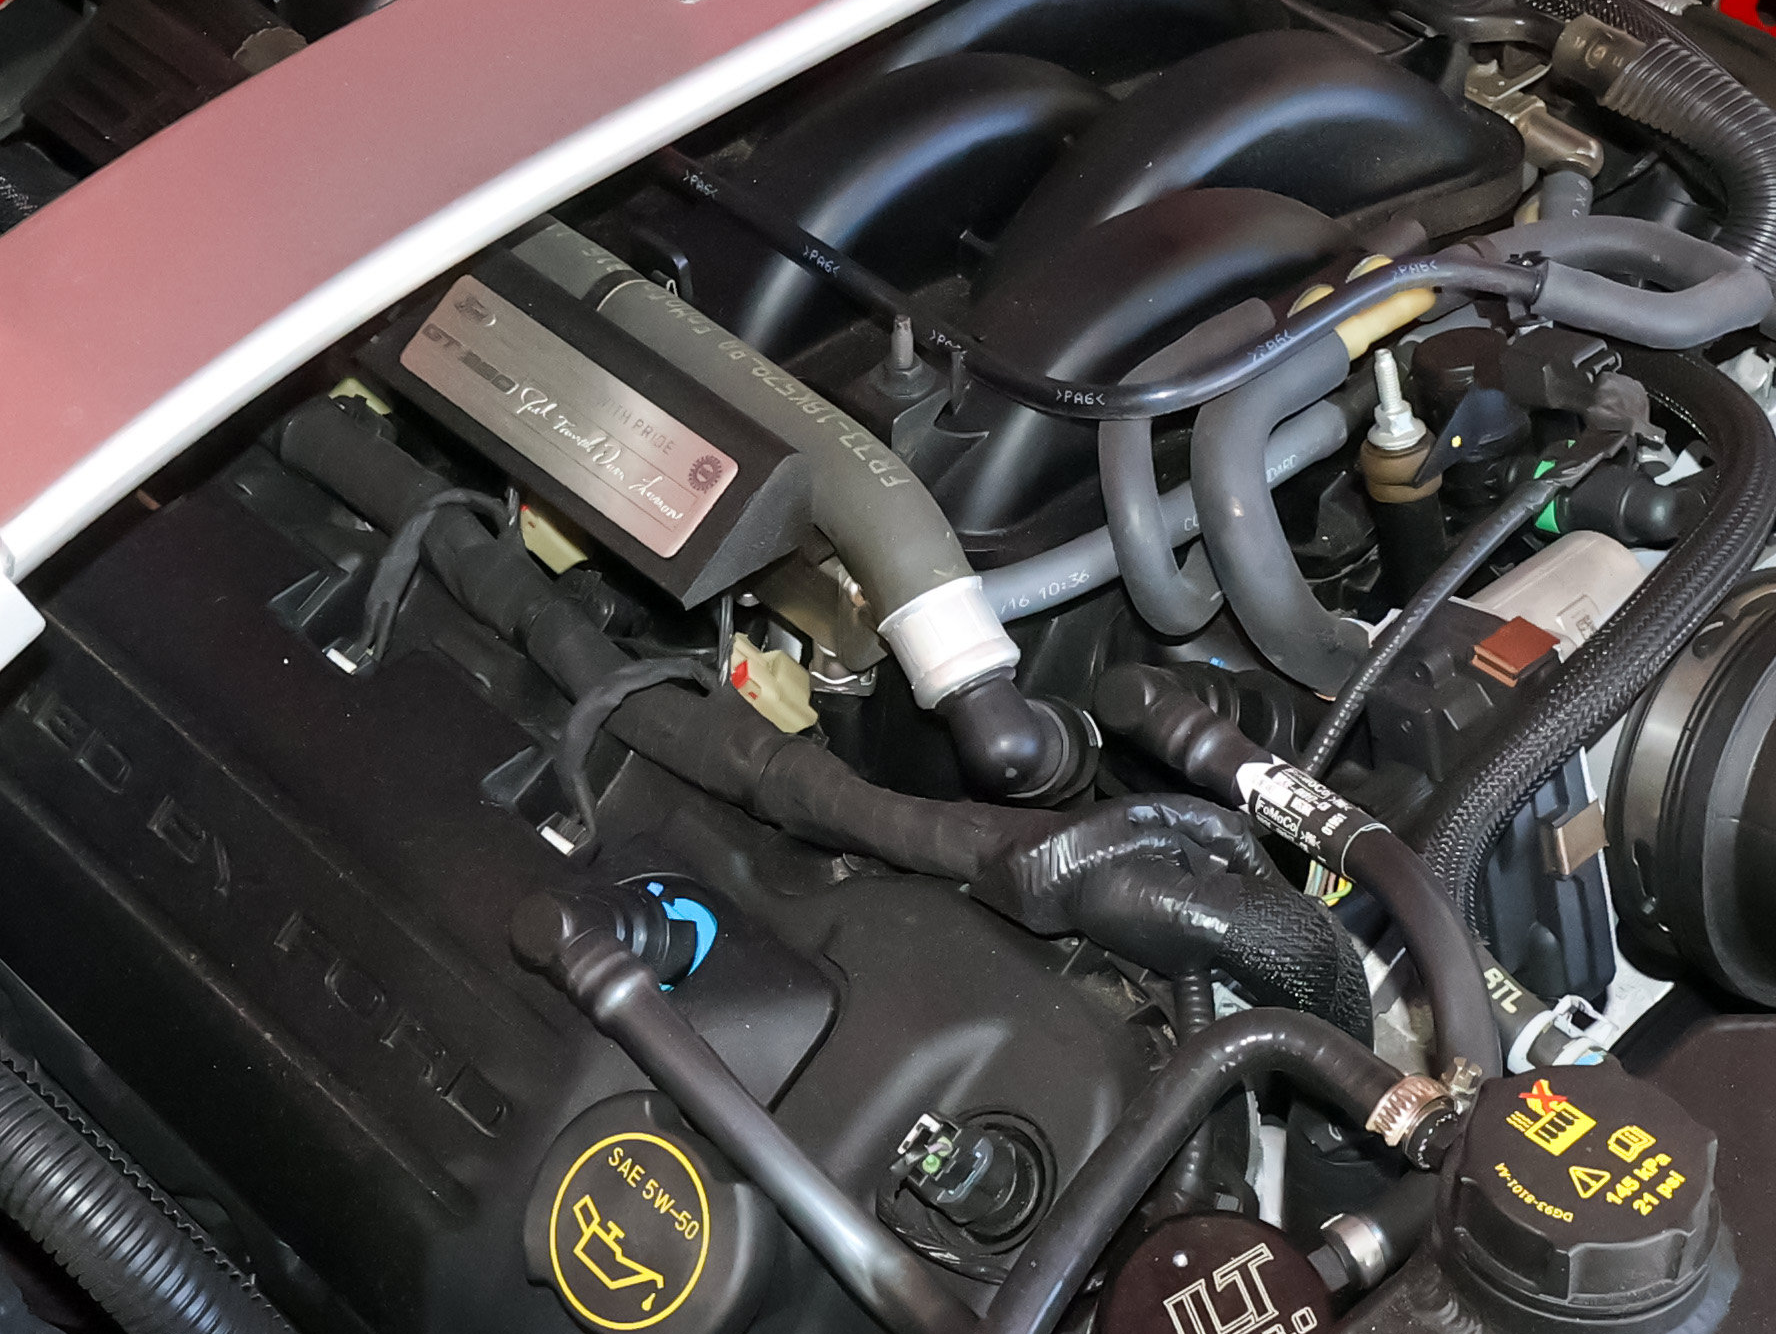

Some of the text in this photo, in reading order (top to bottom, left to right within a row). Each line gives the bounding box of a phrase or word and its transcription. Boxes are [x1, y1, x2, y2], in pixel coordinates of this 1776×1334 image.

[630, 417, 678, 456] PRIDE
[1038, 570, 1090, 601] 10:36
[1255, 799, 1298, 833] FoMoCo
[608, 1147, 700, 1240] SAE 5W-50
[1605, 1152, 1672, 1205] 145 kPa
[1632, 1169, 1686, 1216] 21 psi
